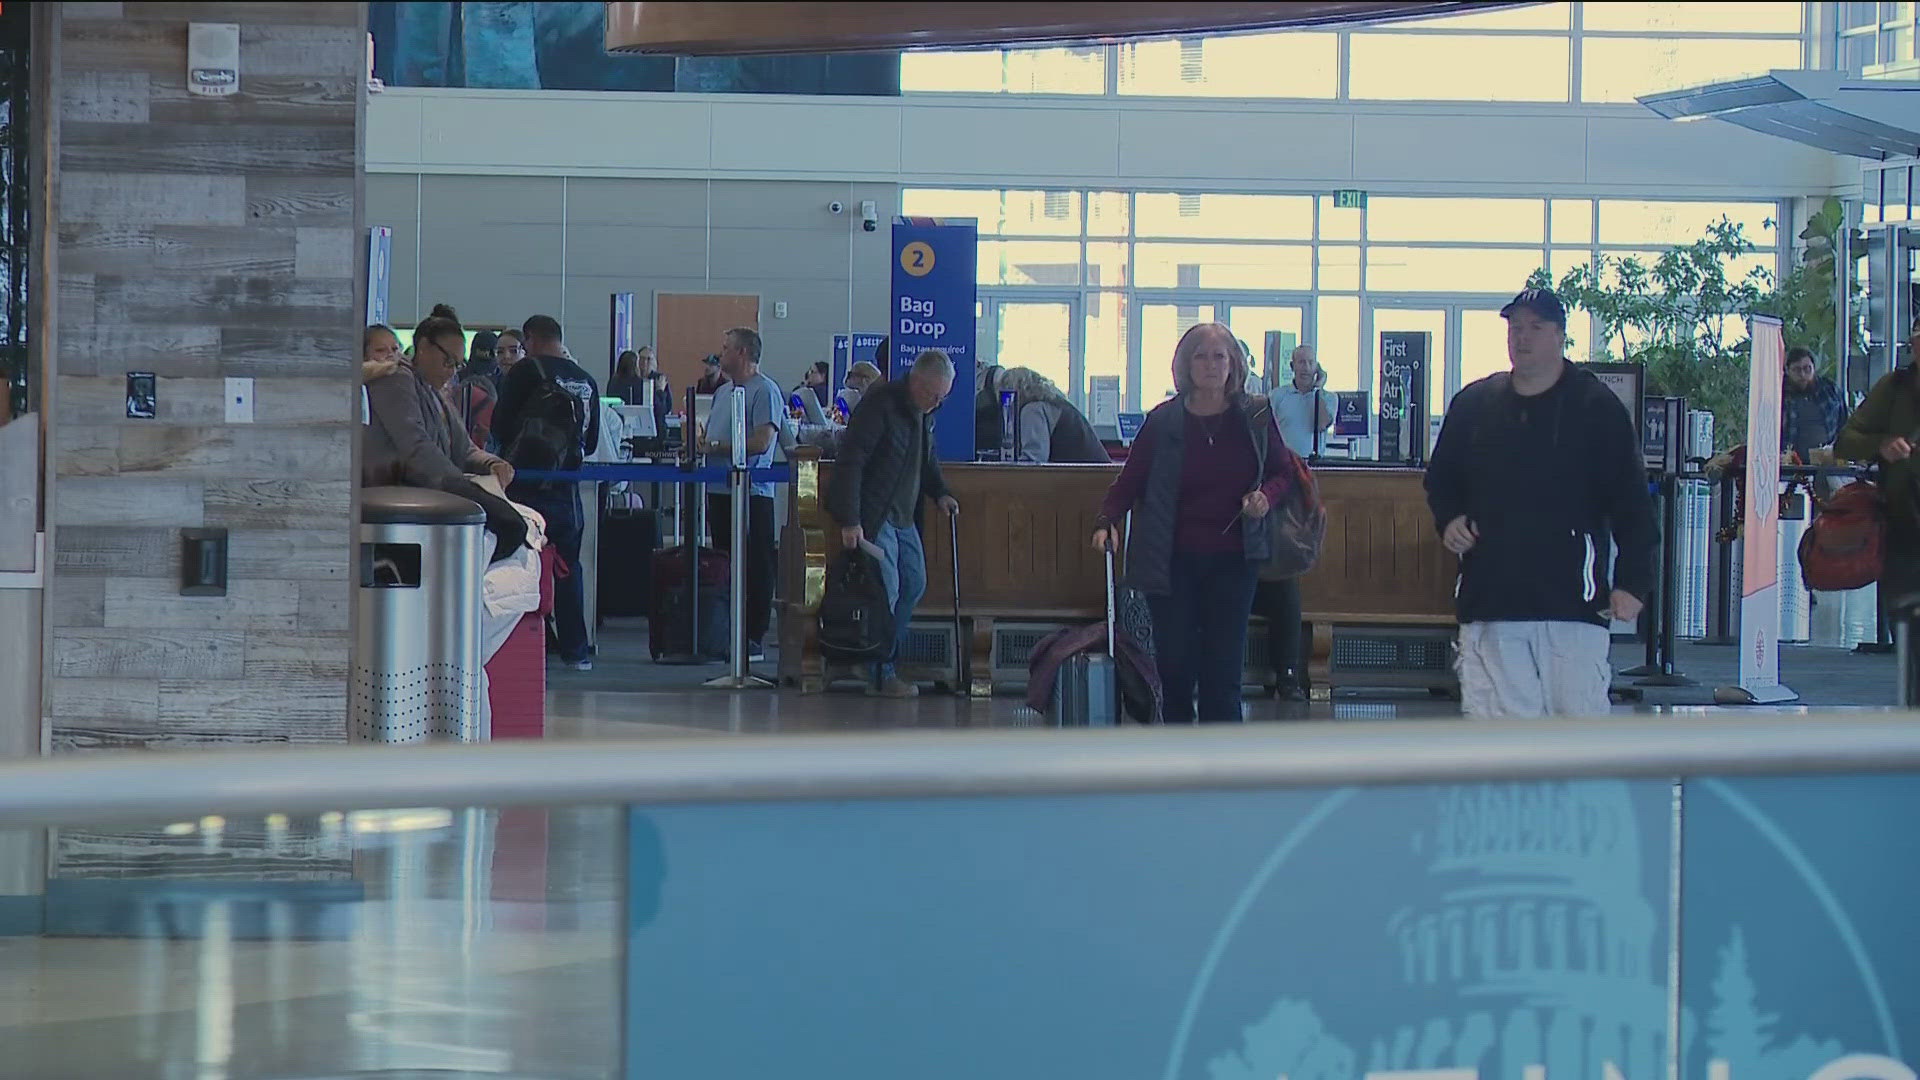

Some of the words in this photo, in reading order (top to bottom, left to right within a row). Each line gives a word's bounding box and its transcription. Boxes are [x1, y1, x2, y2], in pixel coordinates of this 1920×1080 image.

[1340, 191, 1361, 207] EXIT
[912, 250, 924, 267] 2
[900, 296, 934, 317] Bag
[900, 318, 945, 340] Drop
[900, 344, 916, 355] Bag
[1383, 339, 1407, 357] First
[1383, 360, 1410, 378] Cla
[1382, 402, 1399, 420] Sta
